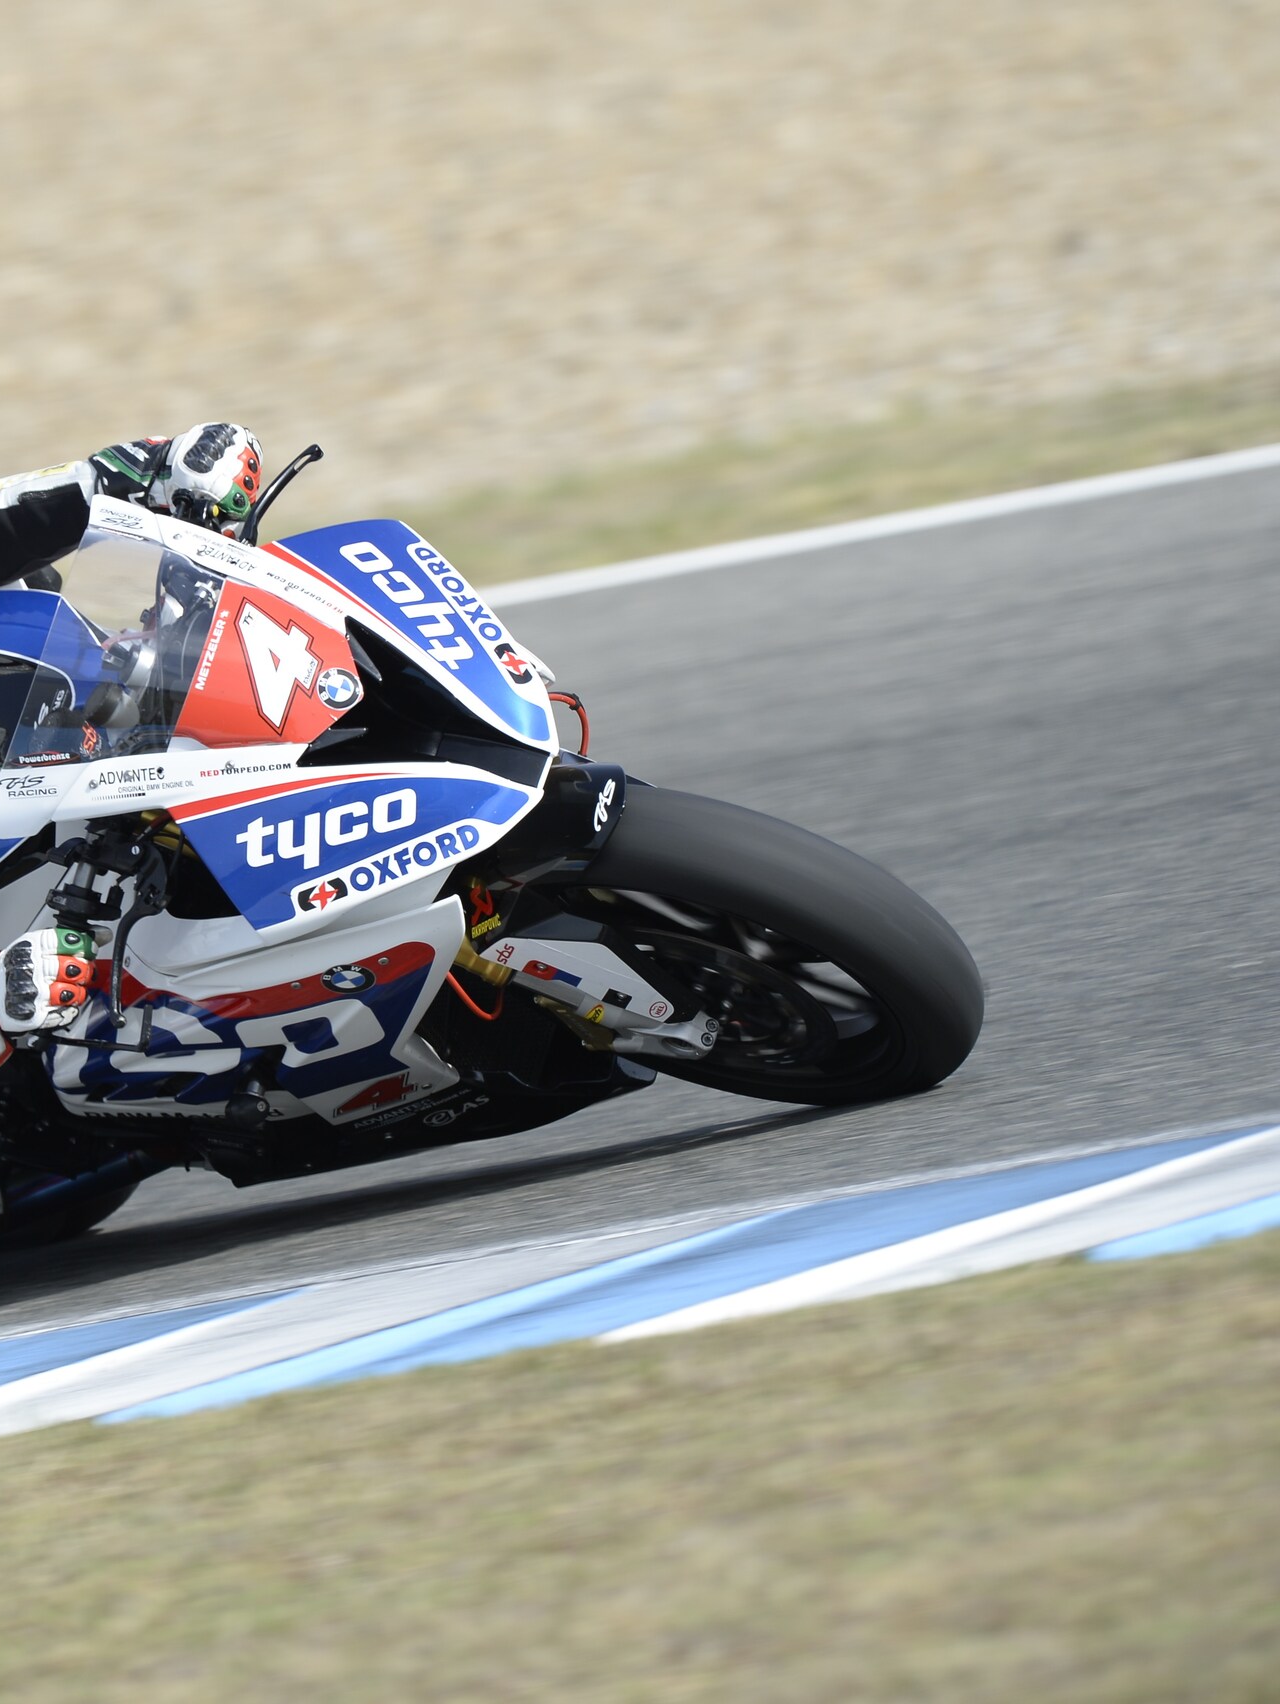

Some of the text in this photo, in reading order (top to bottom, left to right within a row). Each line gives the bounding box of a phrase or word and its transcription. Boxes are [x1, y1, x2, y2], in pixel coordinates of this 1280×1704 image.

[339, 541, 474, 671] tyco
[414, 546, 503, 641] OXFORD
[194, 620, 226, 691] METZELER
[234, 597, 324, 737] 4
[8, 787, 58, 798] RACING
[18, 752, 71, 764] Powerbronze
[117, 780, 195, 794] ORIGINAL BMW ENGINE OIL
[199, 762, 292, 778] REDTORPEDO.COM
[235, 787, 417, 870] tyco
[349, 824, 480, 892] OXFORD
